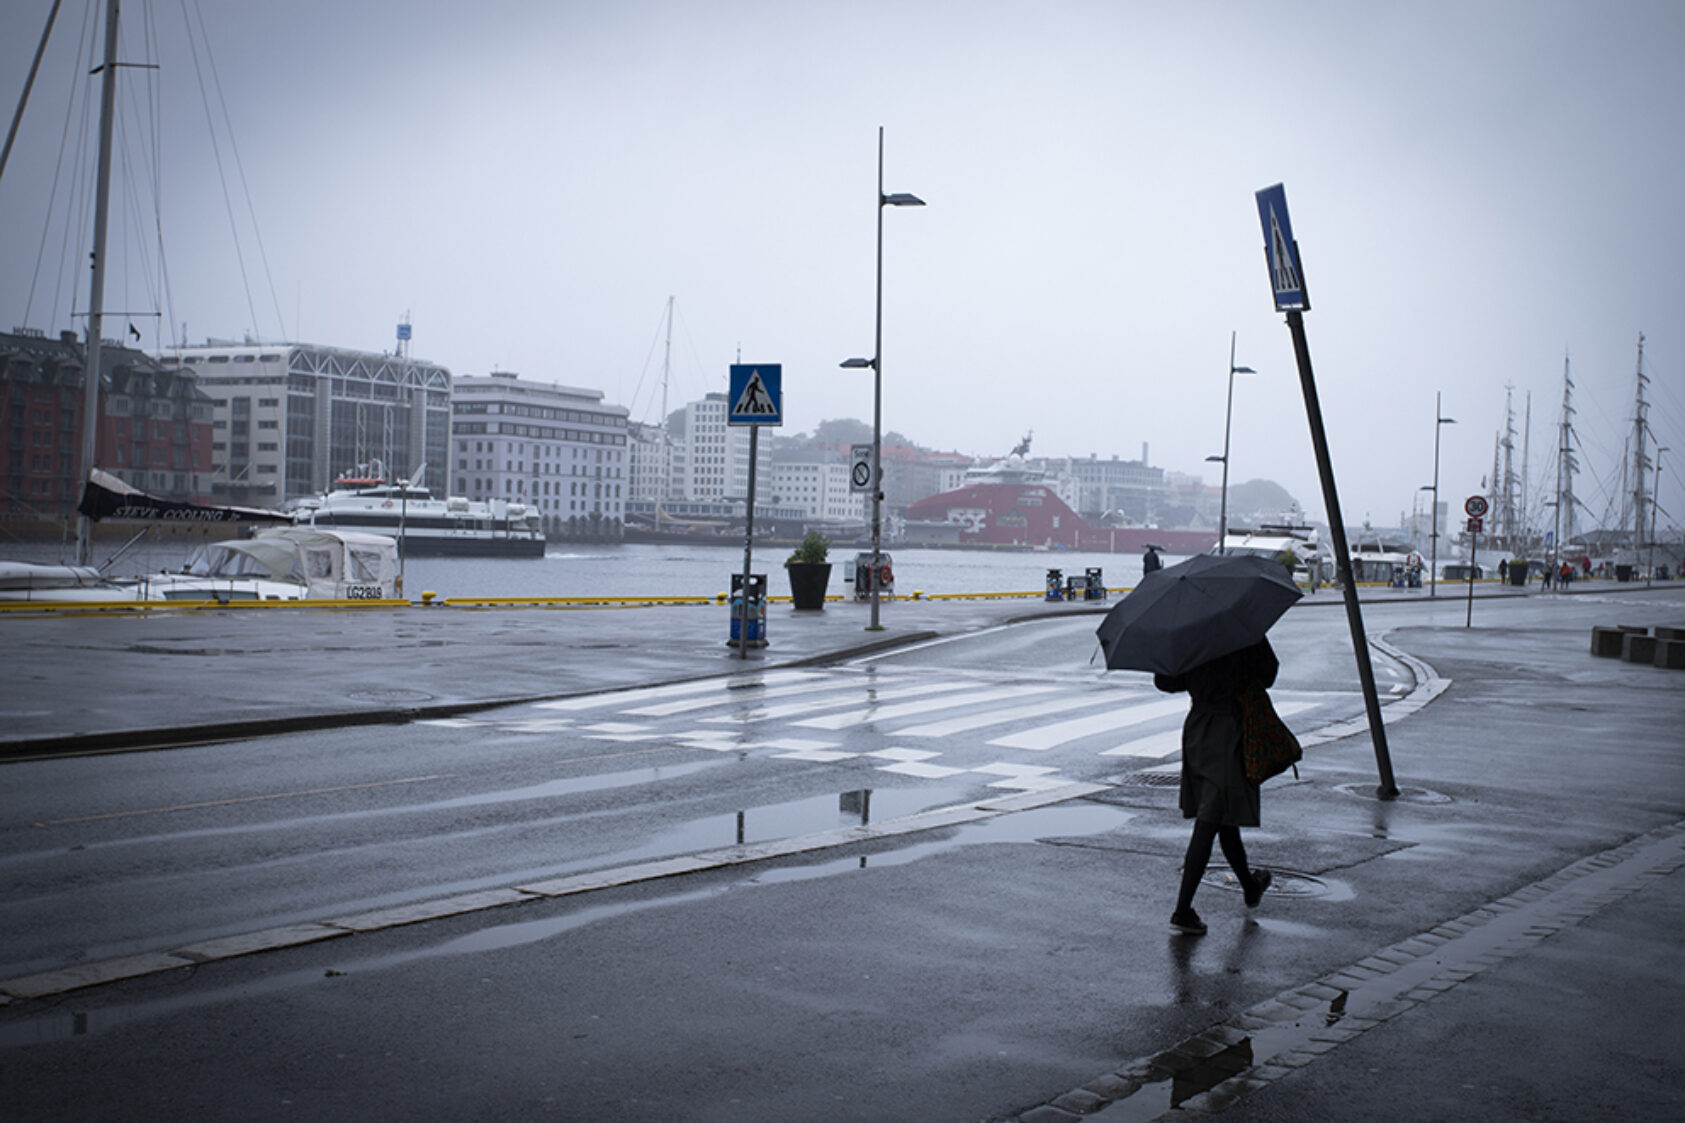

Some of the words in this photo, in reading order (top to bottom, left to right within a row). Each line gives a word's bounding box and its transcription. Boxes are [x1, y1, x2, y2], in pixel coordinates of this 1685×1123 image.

[13, 326, 46, 339] HOTEL
[1470, 500, 1484, 512] 30
[113, 505, 159, 518] STEVE
[162, 508, 224, 521] COOLING
